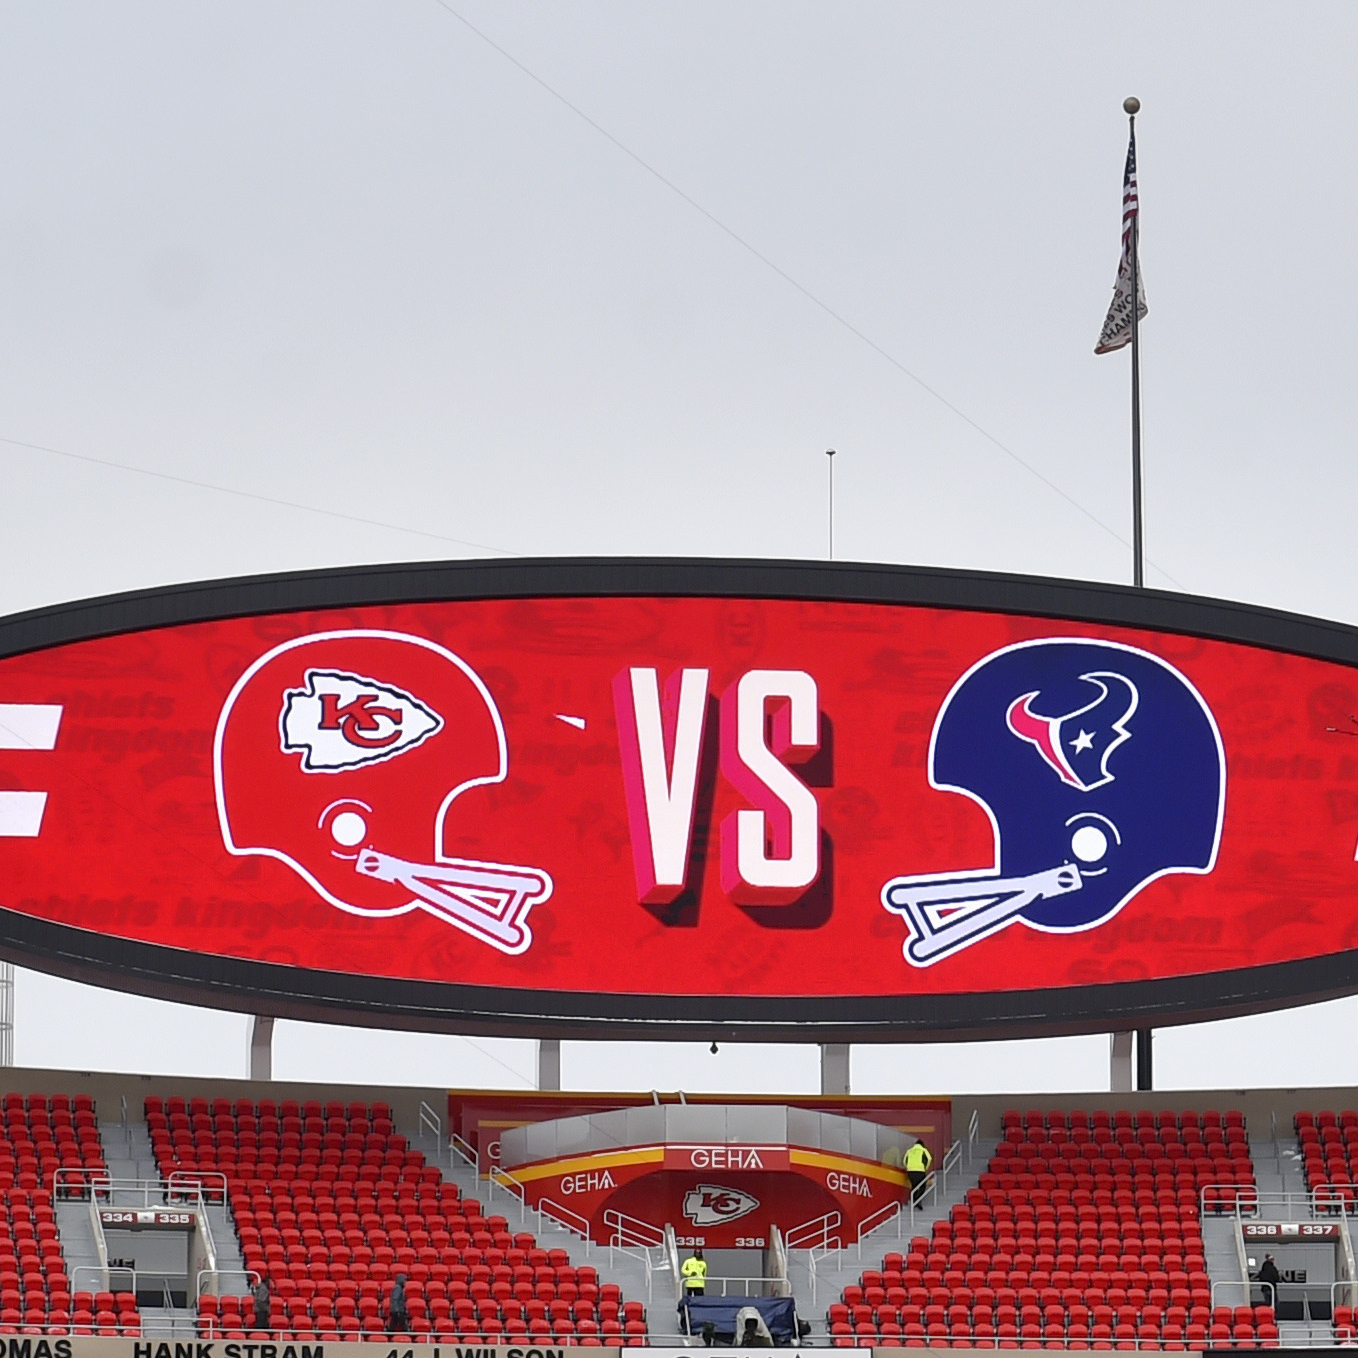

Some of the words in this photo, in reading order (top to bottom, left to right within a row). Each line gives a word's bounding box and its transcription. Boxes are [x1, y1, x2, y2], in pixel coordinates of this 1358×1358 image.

[612, 666, 818, 906] VS
[690, 1148, 764, 1169] GEHA
[560, 1169, 615, 1196] GEHA
[825, 1171, 871, 1198] GEHA
[101, 1212, 133, 1224] 334
[159, 1213, 190, 1225] 335
[1246, 1225, 1277, 1235] 336
[1302, 1225, 1333, 1235] 337
[675, 1236, 706, 1246] 335
[735, 1237, 766, 1247] 336
